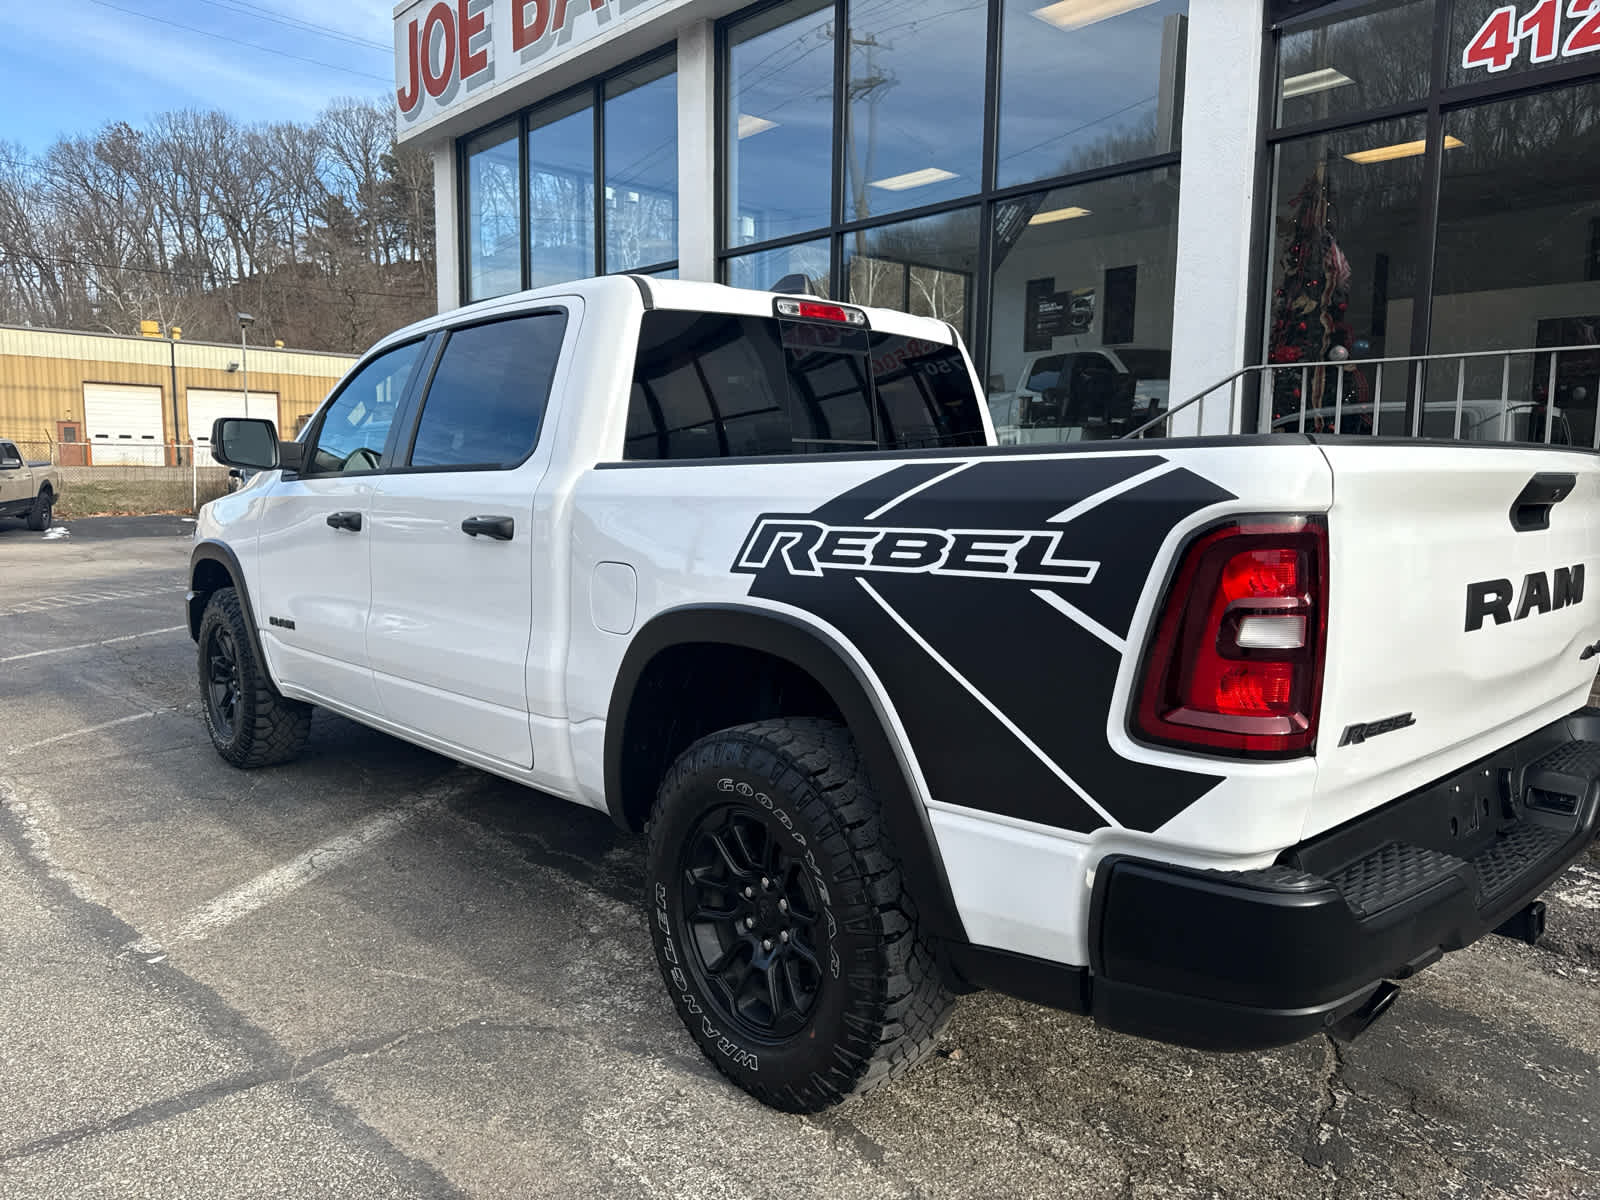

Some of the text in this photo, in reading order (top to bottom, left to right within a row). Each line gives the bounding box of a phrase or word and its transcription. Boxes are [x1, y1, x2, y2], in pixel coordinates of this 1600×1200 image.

[397, 0, 491, 116] JOE
[1462, 0, 1600, 73] 412
[737, 518, 1101, 585] REBEL
[1464, 563, 1585, 632] RAM
[717, 777, 841, 979] GOODYEAR
[655, 881, 760, 1071] WRANGLER
